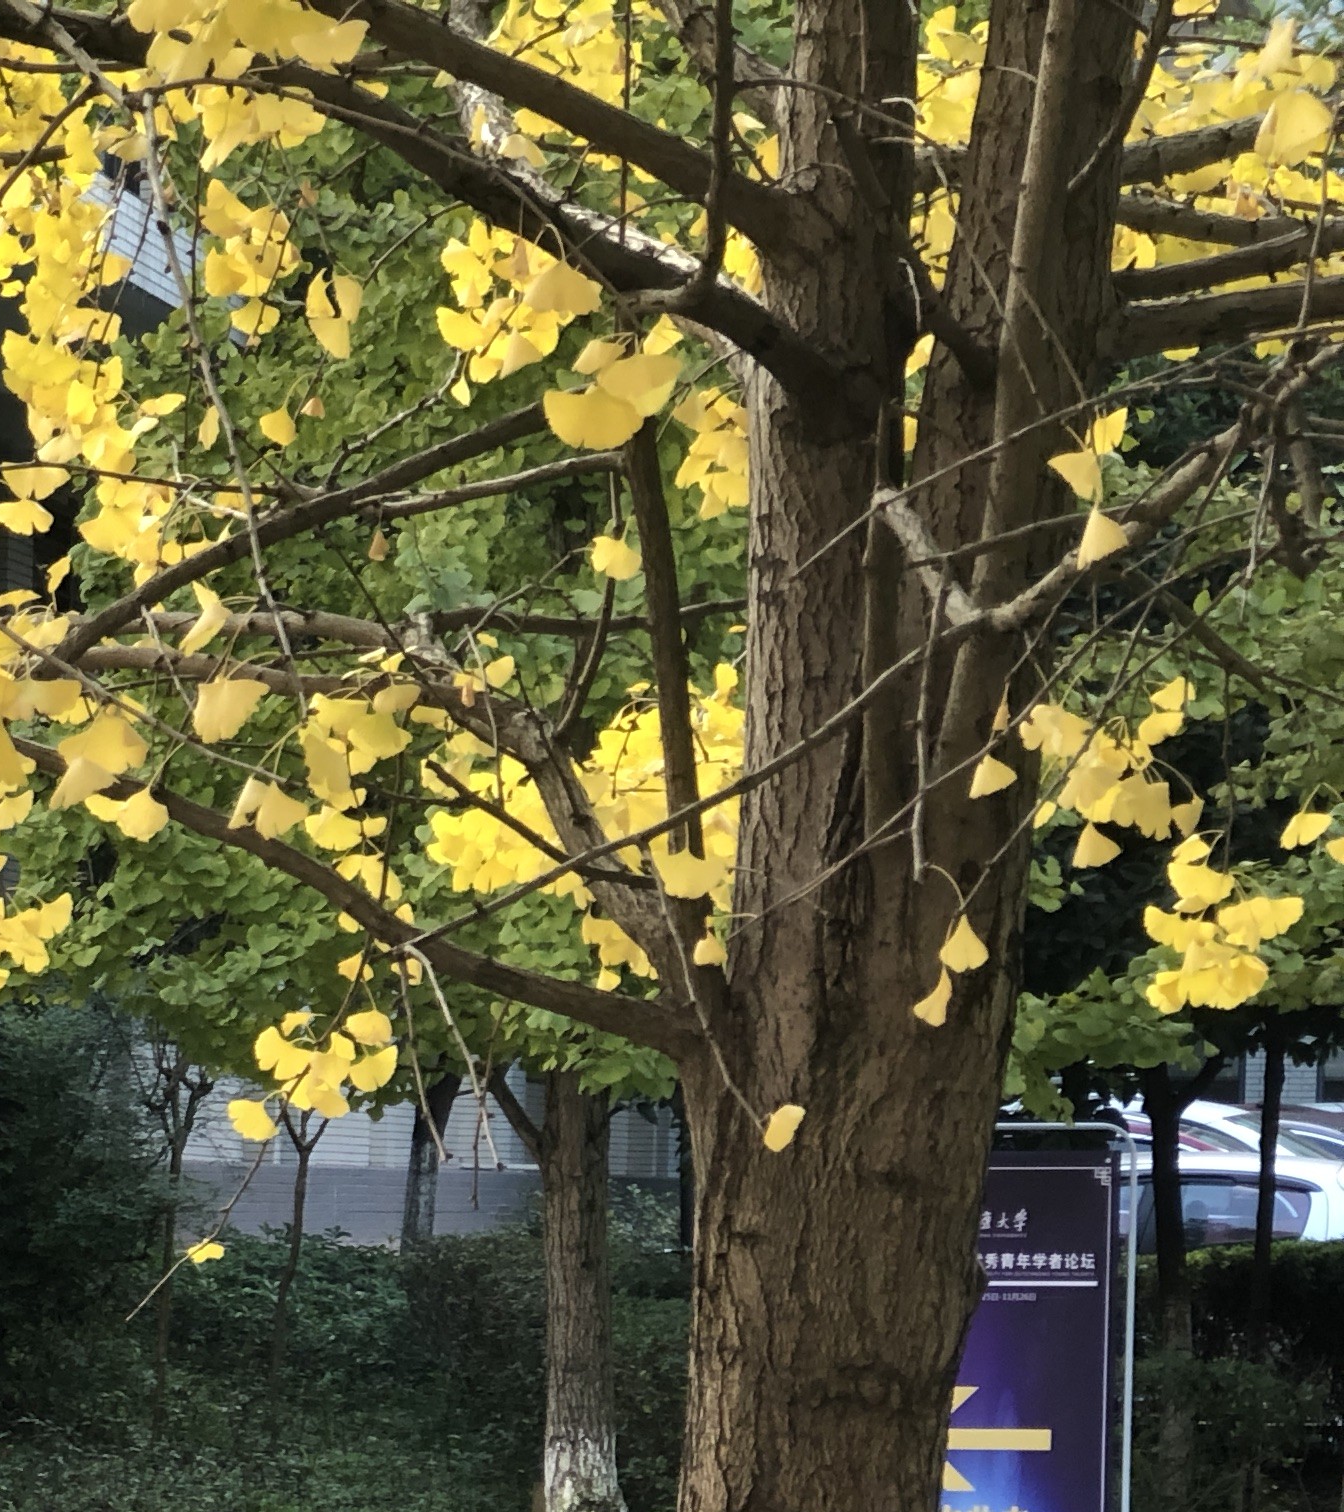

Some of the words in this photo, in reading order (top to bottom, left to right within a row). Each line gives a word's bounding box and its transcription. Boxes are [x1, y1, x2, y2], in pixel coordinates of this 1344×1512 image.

[977, 1253, 1096, 1270] 秀青年学者论坛
